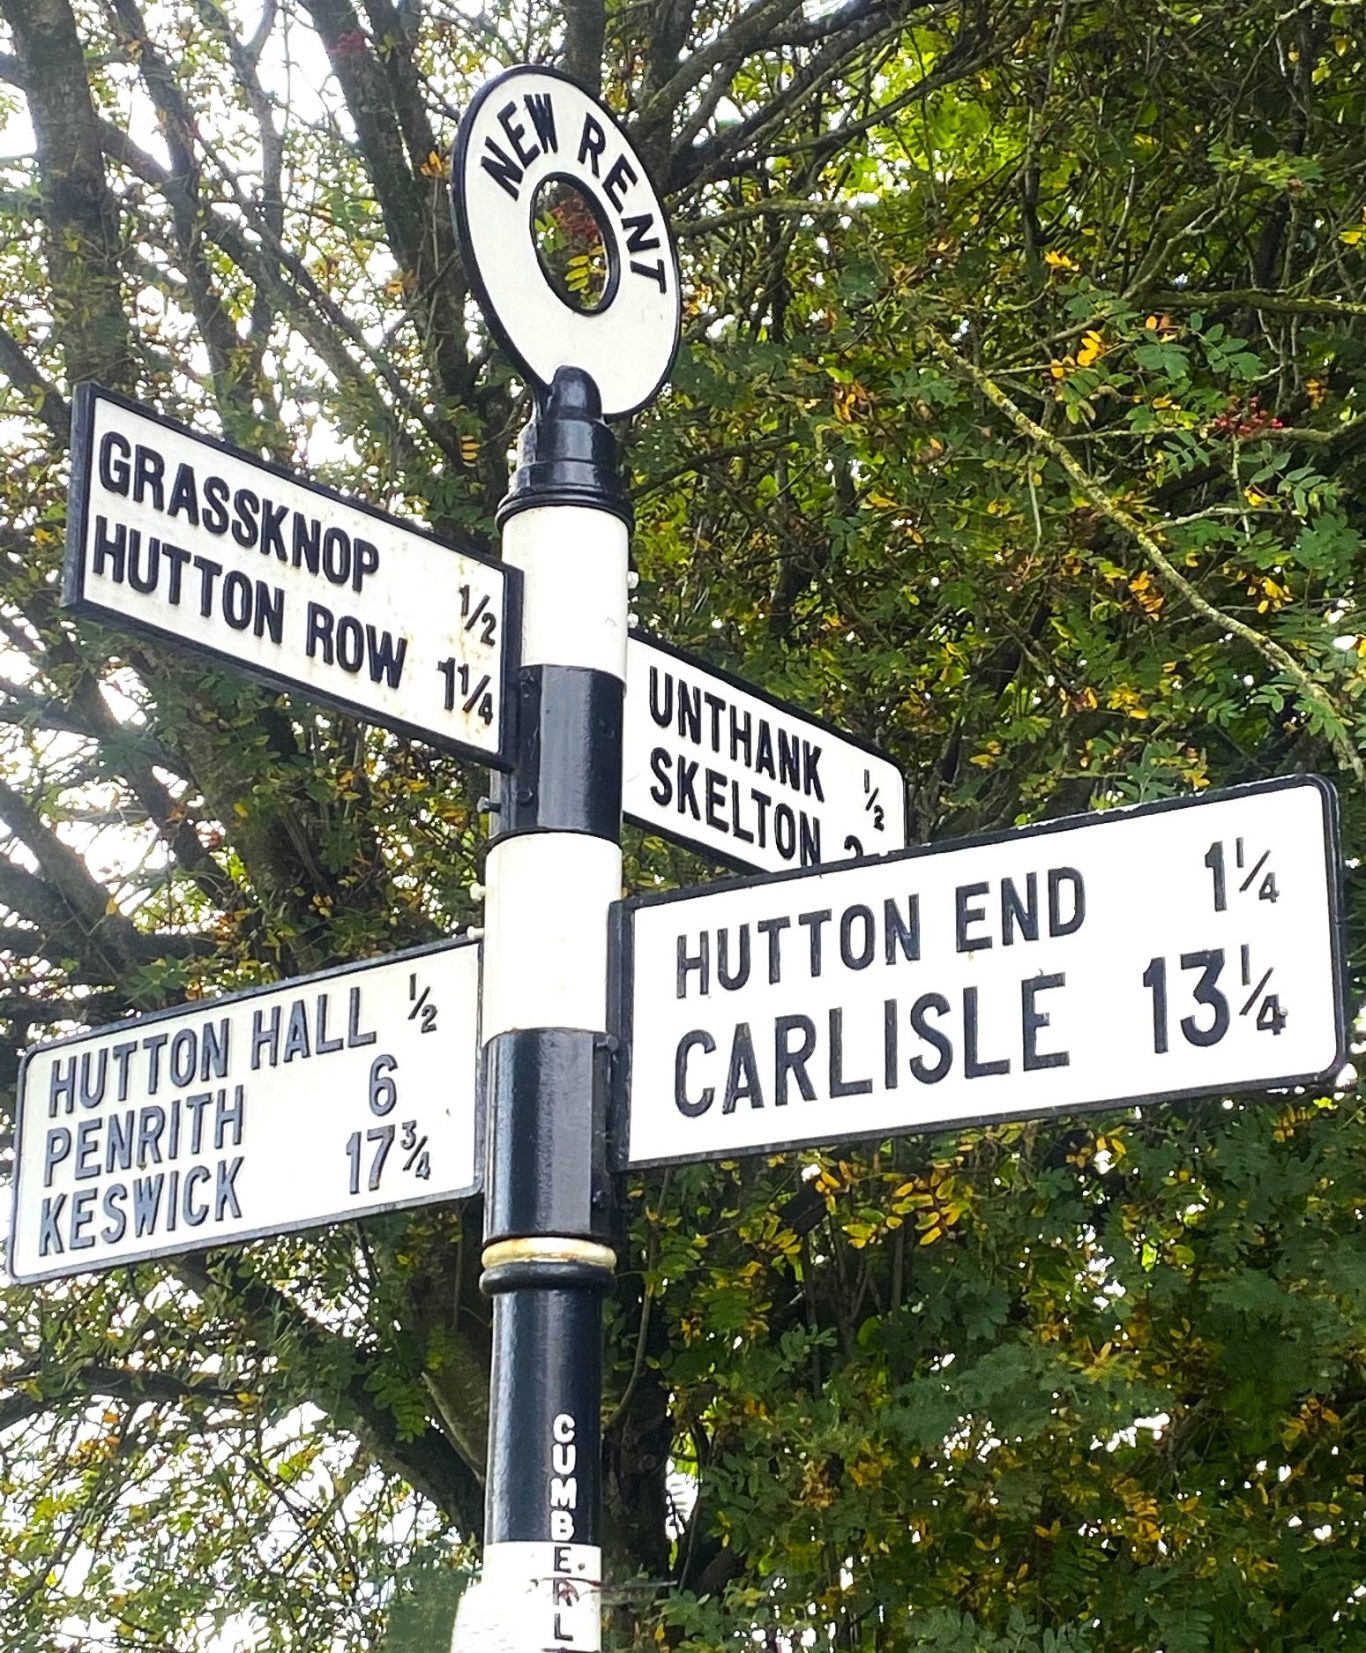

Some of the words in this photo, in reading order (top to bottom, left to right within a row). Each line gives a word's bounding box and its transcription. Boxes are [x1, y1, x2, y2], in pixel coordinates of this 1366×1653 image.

[481, 93, 559, 201] NEW
[577, 112, 667, 294] RENT
[99, 432, 380, 592] GRASSKNOP
[93, 515, 285, 645] HUTTON
[305, 601, 408, 689] ROW
[649, 665, 825, 803] UNTHANK
[650, 746, 822, 868] SKELTON
[676, 893, 921, 1000] HUTTON
[956, 867, 1086, 953] END
[48, 1017, 230, 1118] HUTTON
[250, 986, 377, 1070] HALL
[675, 970, 1070, 1118] CARLISLE
[43, 1084, 247, 1188] PENRITH
[368, 1054, 399, 1117] 6
[38, 1156, 245, 1257] KESWICK
